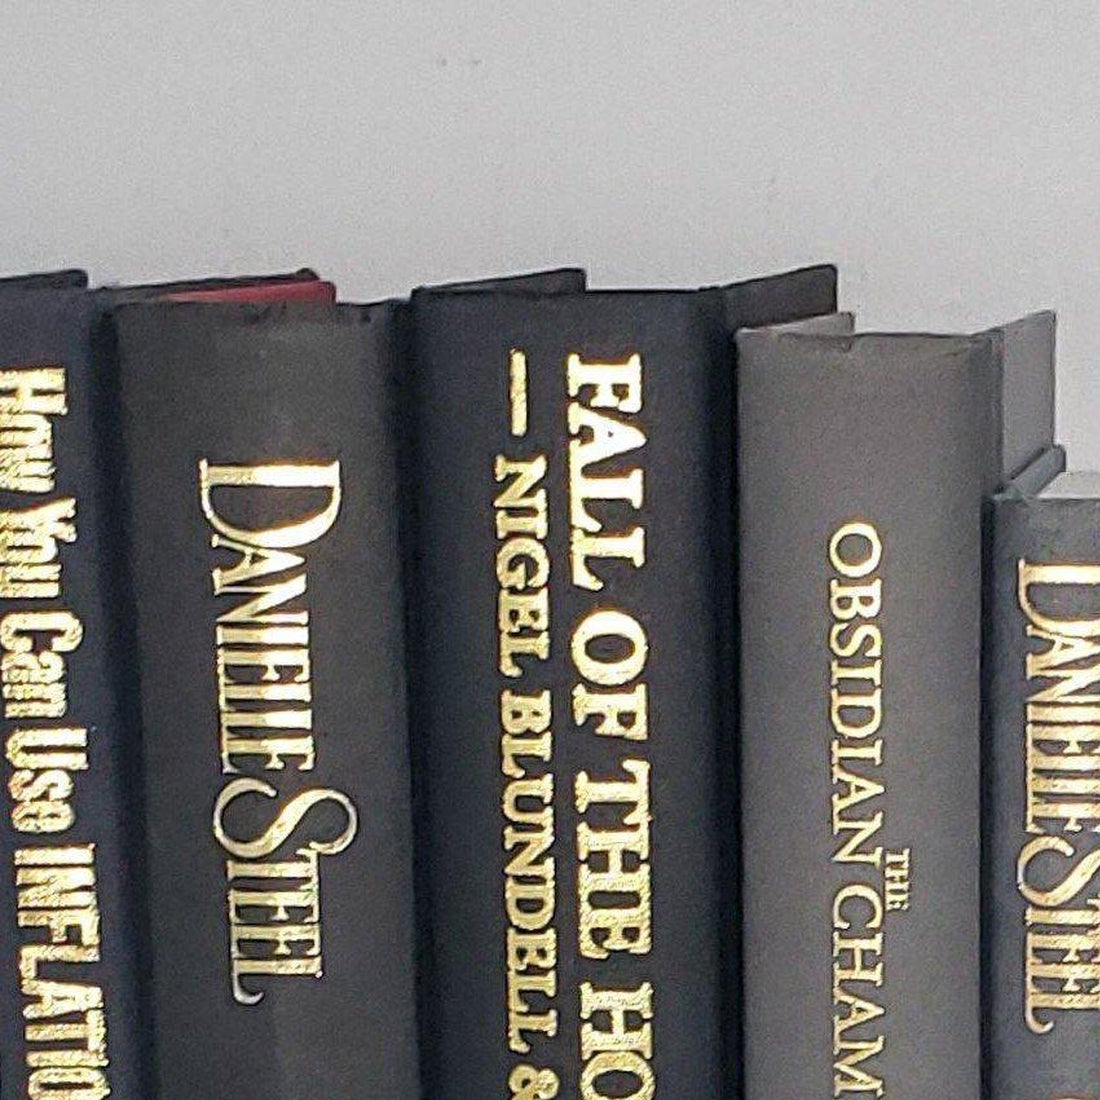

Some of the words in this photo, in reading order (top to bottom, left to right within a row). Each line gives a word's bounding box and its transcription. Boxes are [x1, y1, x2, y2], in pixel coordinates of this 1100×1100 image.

[0, 368, 68, 492] How
[567, 353, 646, 590] FALL
[0, 498, 77, 598] You
[199, 459, 341, 773] DANIELLE
[494, 455, 550, 677] NIGEL
[0, 611, 83, 718] Can
[571, 610, 648, 740] OF
[830, 522, 883, 867] OBSIDIAN
[5, 728, 88, 833] Use
[501, 690, 557, 1053] BLUNDELL
[575, 759, 652, 959] THE
[885, 848, 910, 911] THE
[213, 778, 356, 1003] STEEL
